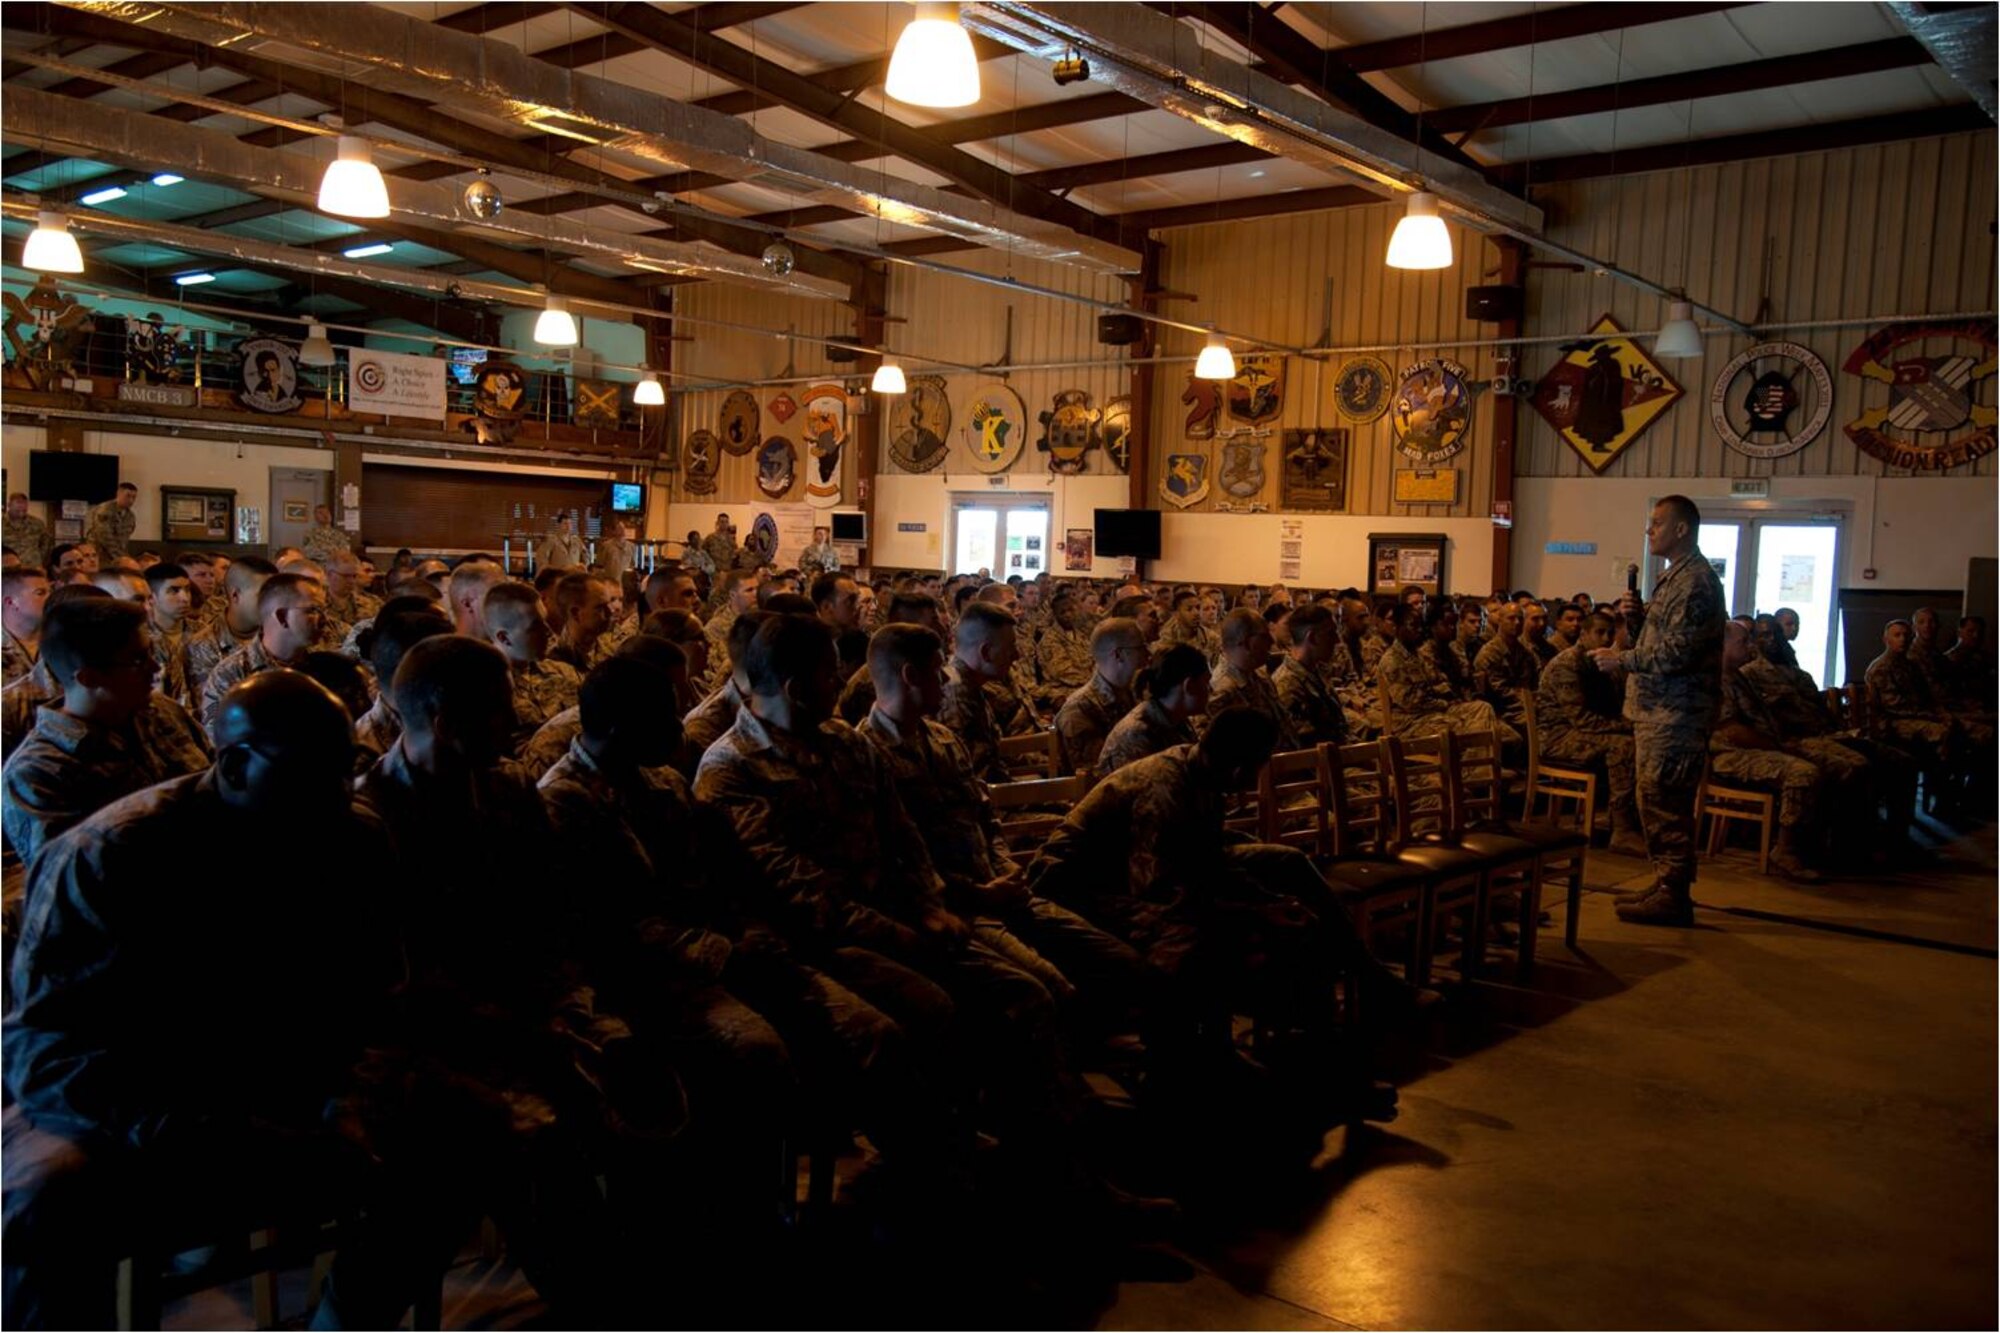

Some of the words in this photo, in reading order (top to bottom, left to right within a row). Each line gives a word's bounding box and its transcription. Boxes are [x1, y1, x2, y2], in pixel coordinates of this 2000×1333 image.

[123, 387, 168, 403] NMCB
[172, 394, 183, 404] 3
[982, 415, 1004, 455] K
[1402, 446, 1423, 461] MAD
[1733, 481, 1763, 493] EXIT
